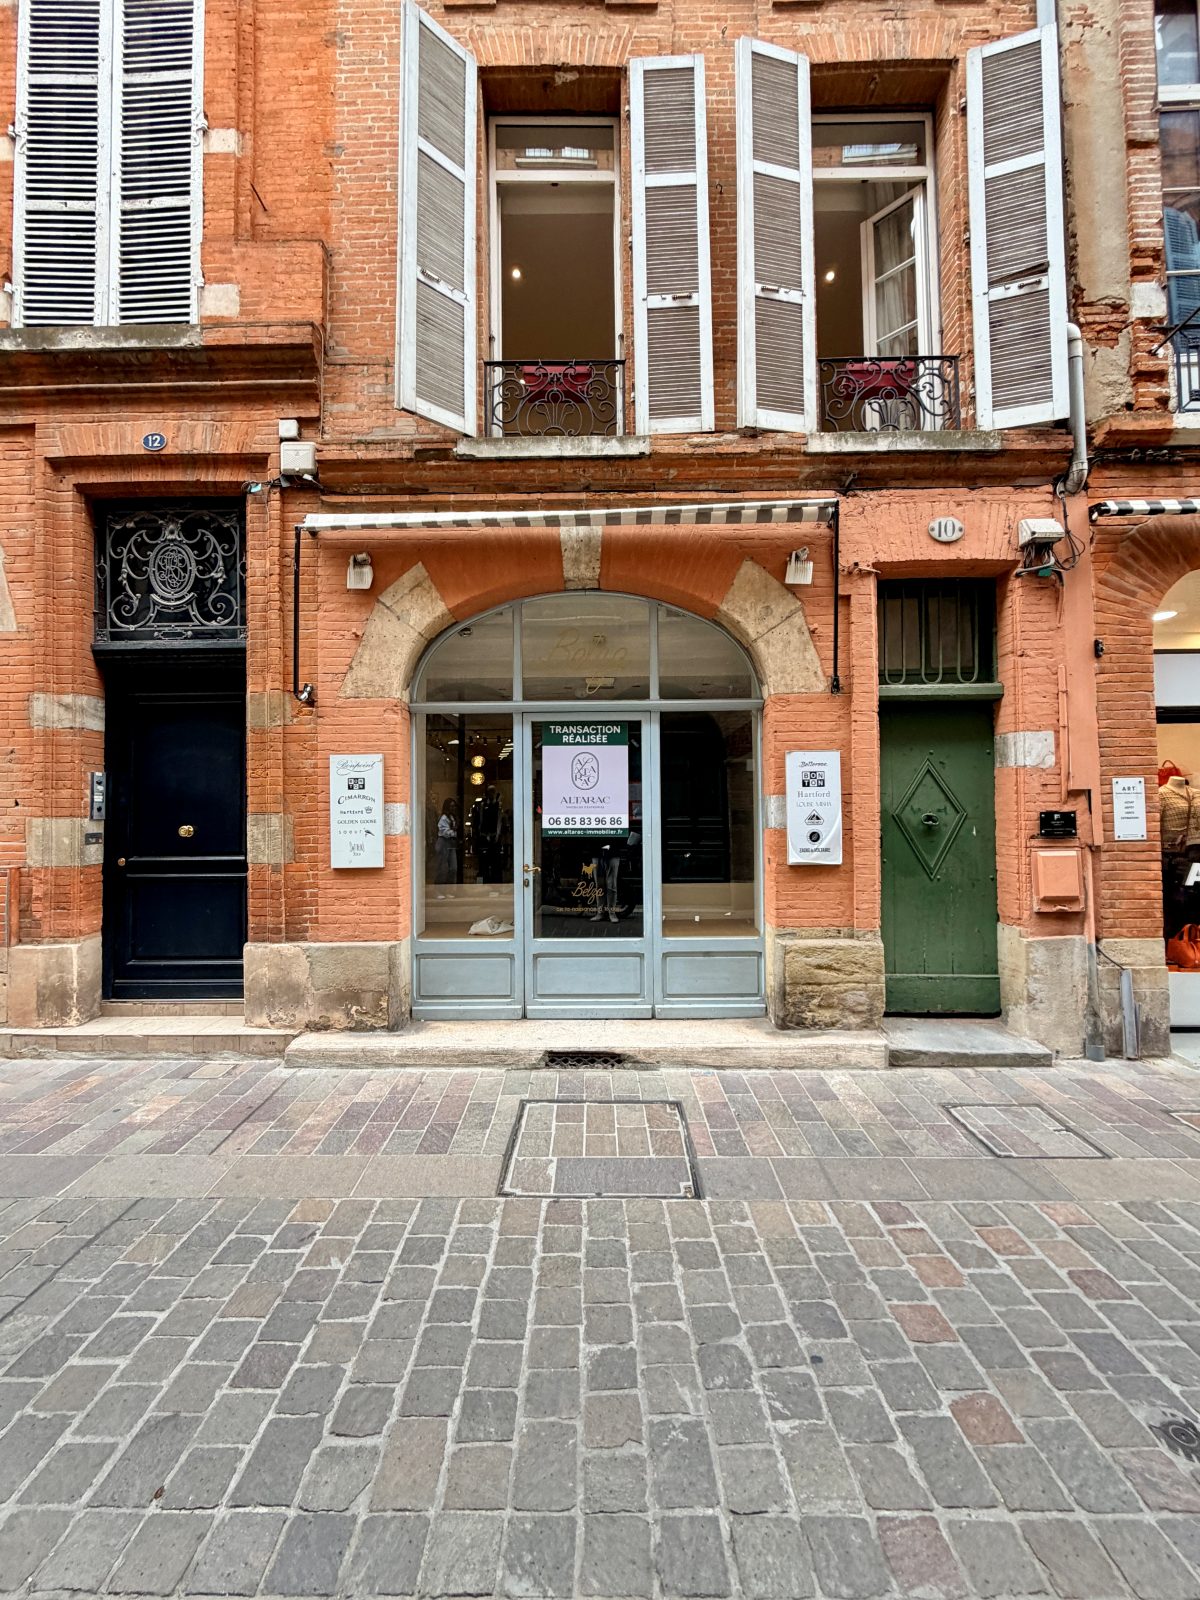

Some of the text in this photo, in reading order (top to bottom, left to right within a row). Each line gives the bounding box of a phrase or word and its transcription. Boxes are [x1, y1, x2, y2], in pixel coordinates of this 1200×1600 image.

[148, 435, 161, 447] 12
[938, 519, 956, 538] 10
[549, 725, 621, 734] TRANSACTION
[562, 733, 608, 743] RÉALISÉE
[803, 771, 824, 779] BON
[803, 779, 825, 787] TON
[797, 790, 831, 798] Hartford
[337, 793, 376, 805] CIMARRON
[560, 796, 611, 804] ALTARAC
[548, 817, 622, 826] 06 85 83 96 86
[571, 881, 605, 905] Belza
